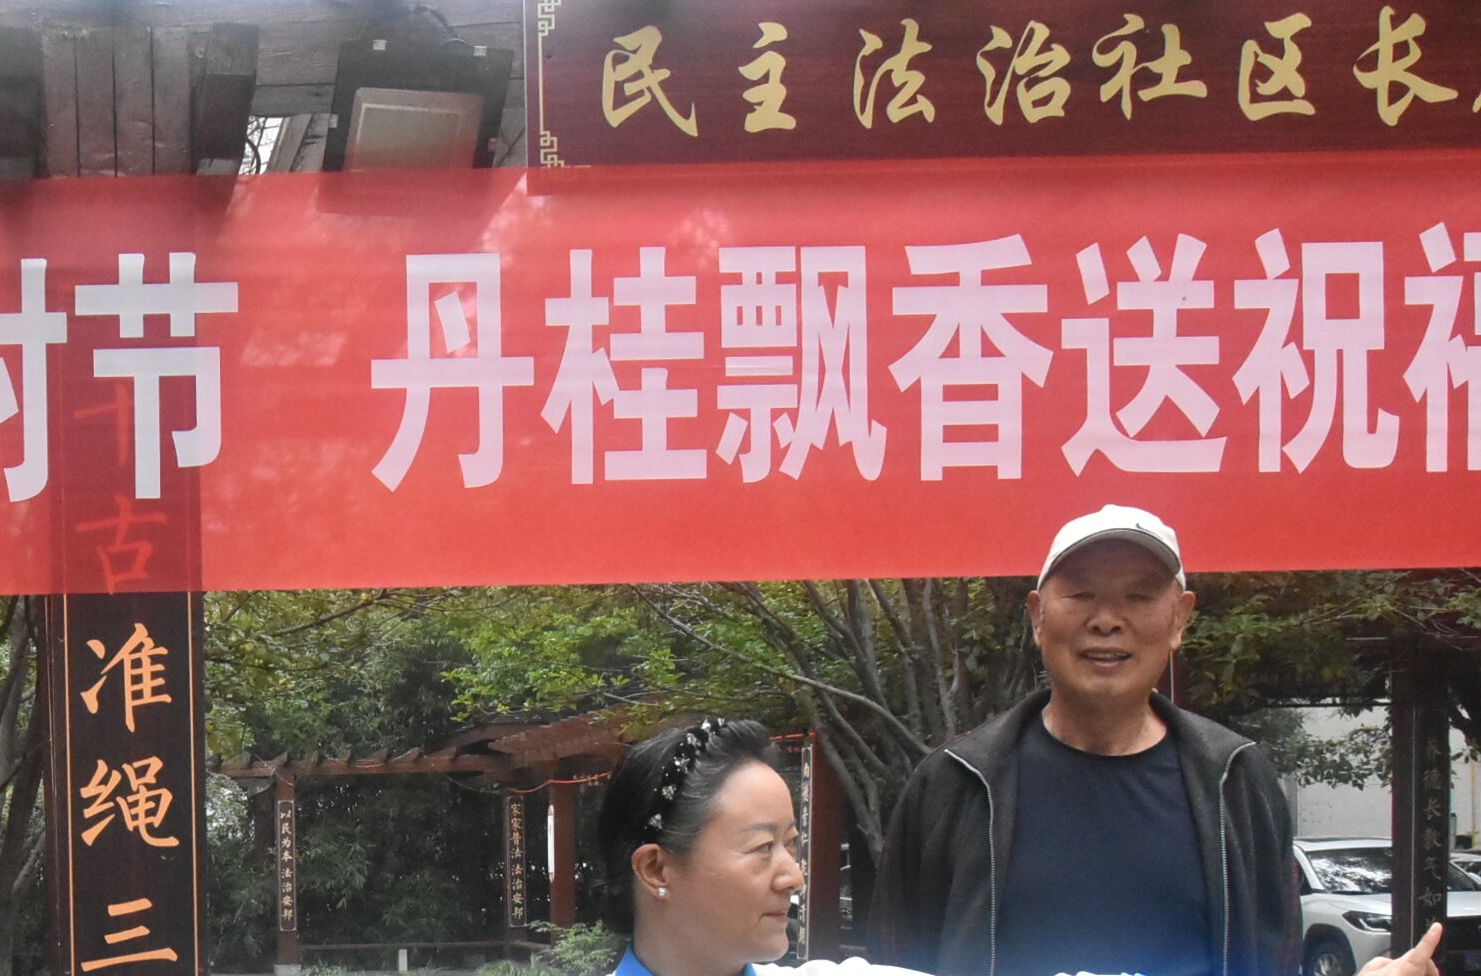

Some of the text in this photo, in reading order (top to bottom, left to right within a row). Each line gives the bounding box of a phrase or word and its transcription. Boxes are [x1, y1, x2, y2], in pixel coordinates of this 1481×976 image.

[601, 5, 1481, 137] 民主法治社区长
